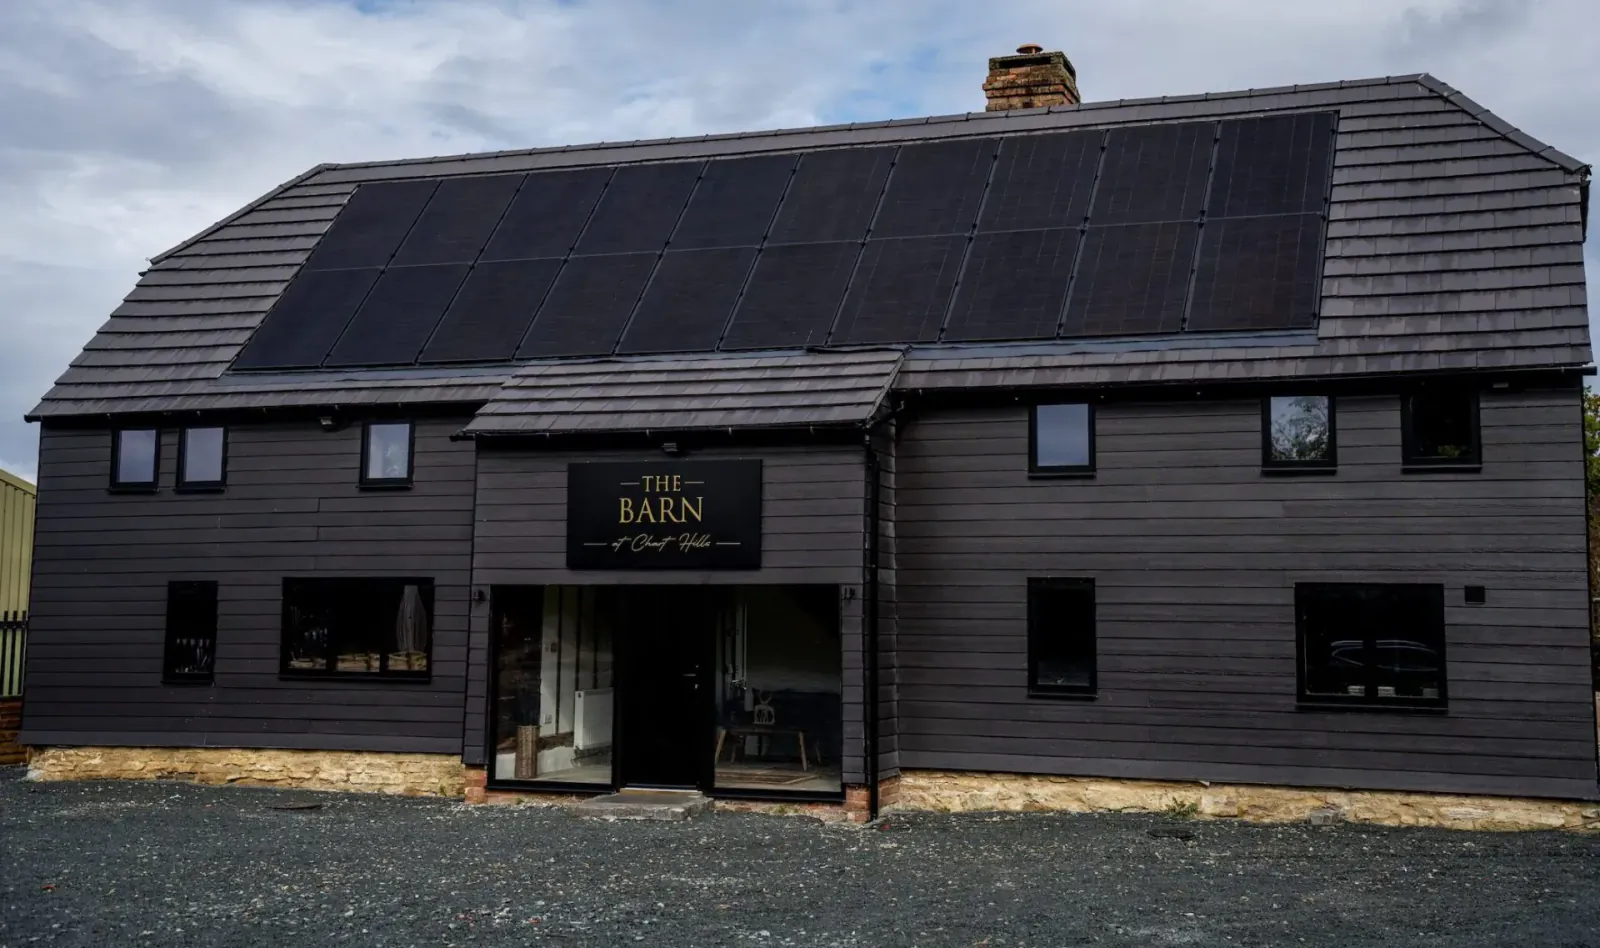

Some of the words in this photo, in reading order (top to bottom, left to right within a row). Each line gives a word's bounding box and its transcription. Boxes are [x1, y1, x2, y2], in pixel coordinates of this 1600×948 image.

[641, 475, 681, 492] THE
[619, 496, 704, 523] BARN
[611, 535, 632, 552] at
[631, 533, 676, 552] Chart
[679, 532, 711, 553] Hills
